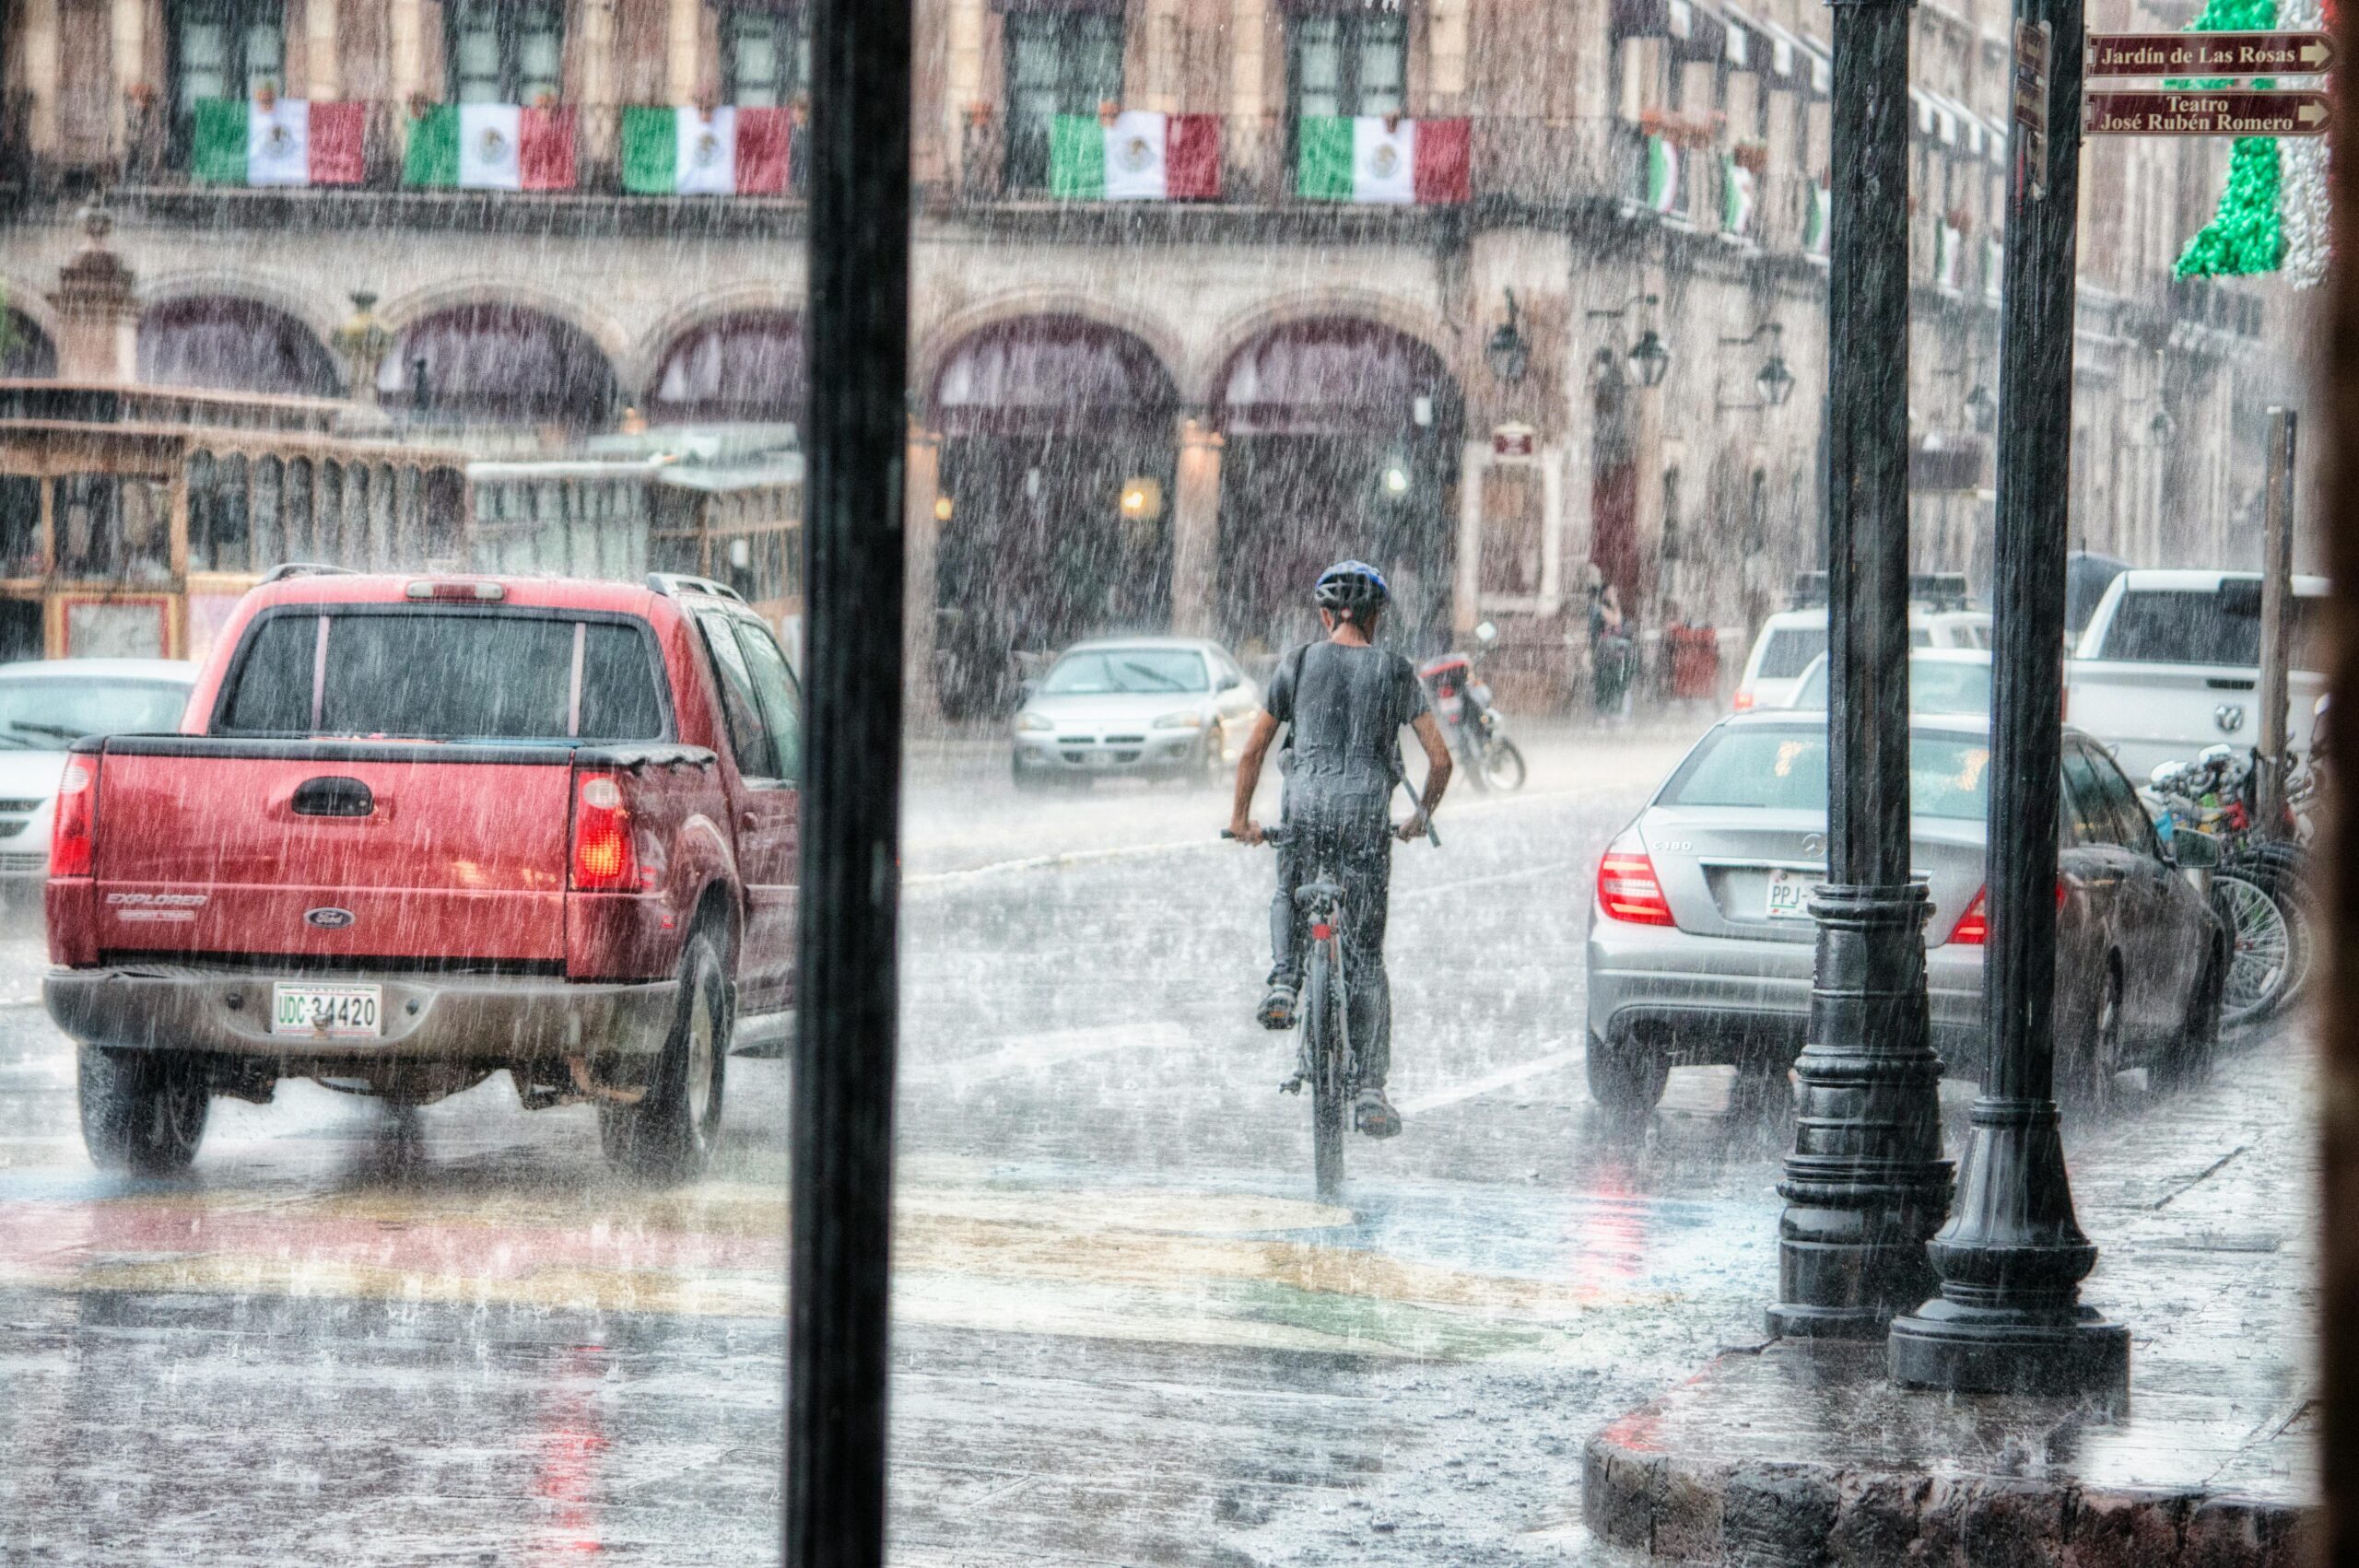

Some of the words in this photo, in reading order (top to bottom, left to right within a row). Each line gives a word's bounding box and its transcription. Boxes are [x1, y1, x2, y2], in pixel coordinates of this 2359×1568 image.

[2101, 47, 2165, 64] Jardín
[2170, 47, 2193, 64] de
[2199, 47, 2234, 64] Las
[2239, 46, 2295, 63] Rosas
[2166, 96, 2229, 112] Teatro
[2101, 113, 2142, 130] José
[2148, 113, 2211, 130] Rubén
[2217, 113, 2294, 131] Romero
[106, 893, 207, 907] EXPLORER
[279, 996, 375, 1026] UDC-34420
